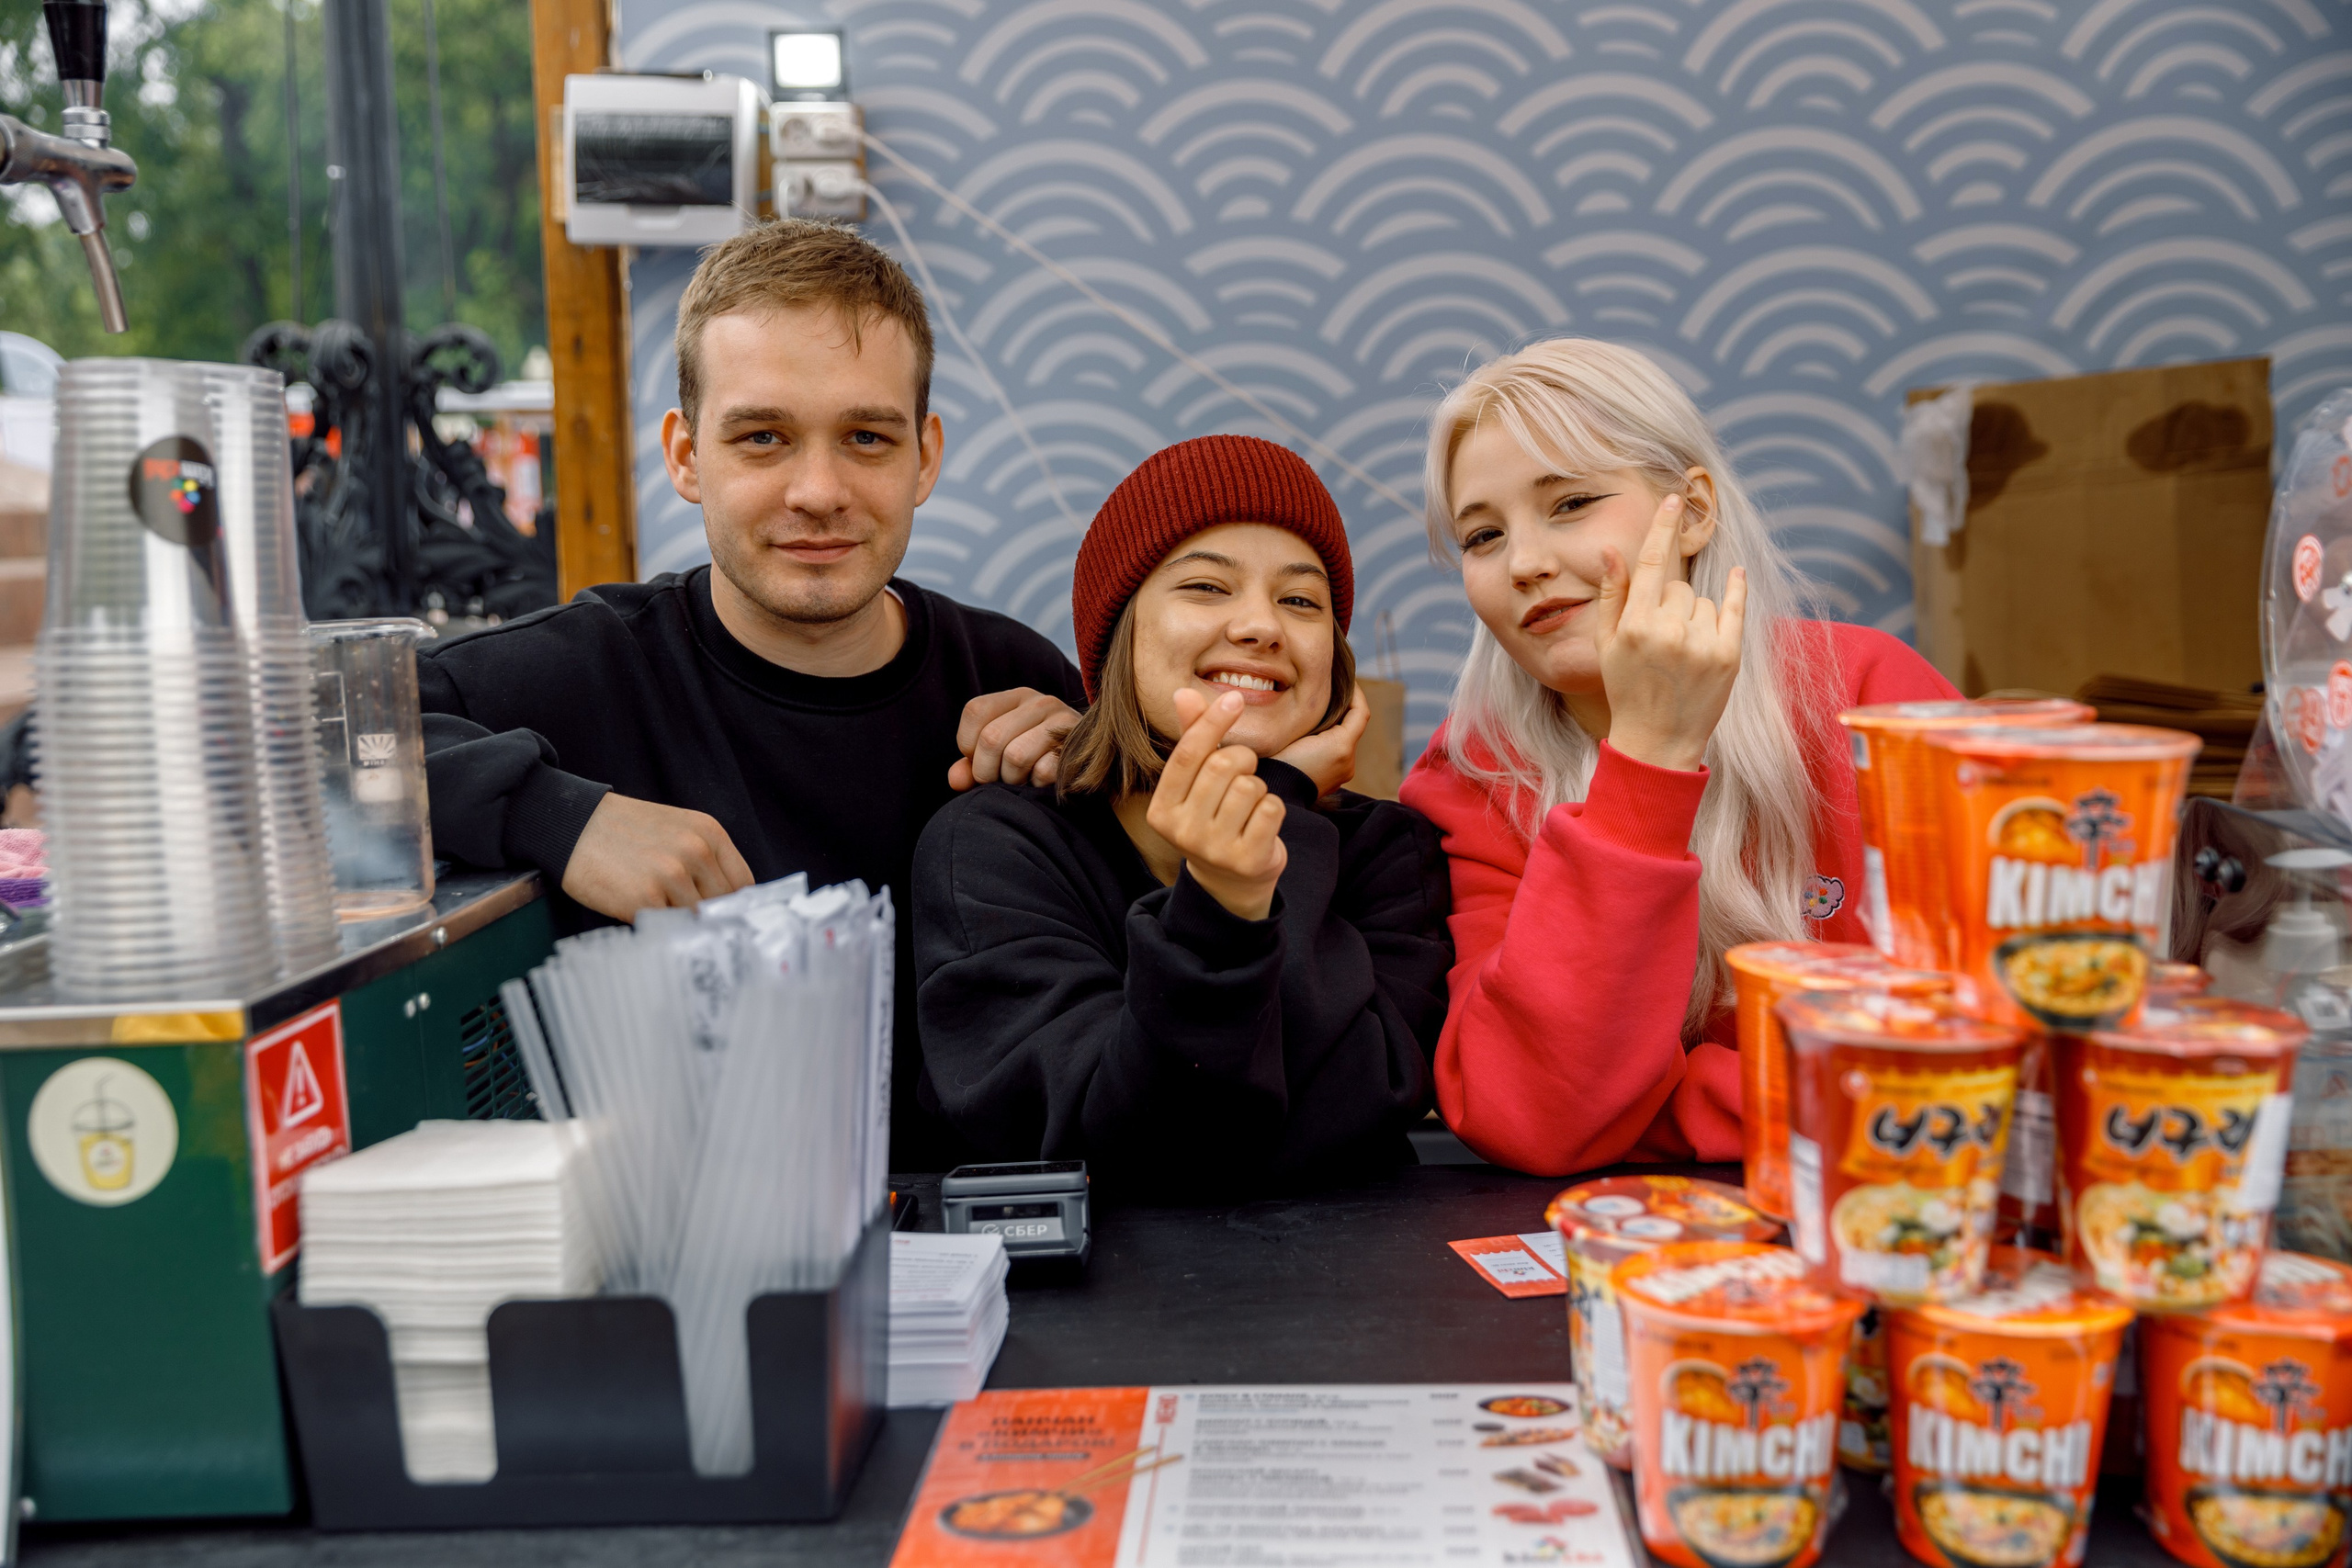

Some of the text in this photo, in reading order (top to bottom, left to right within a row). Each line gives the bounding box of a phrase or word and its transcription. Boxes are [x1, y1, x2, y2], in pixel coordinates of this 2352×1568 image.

[1004, 1224, 1047, 1236] СБЕР
[1660, 1408, 1836, 1479] KIMCHI
[1907, 1403, 2092, 1488] KIMCHI
[2179, 1405, 2352, 1487] KIMCH
